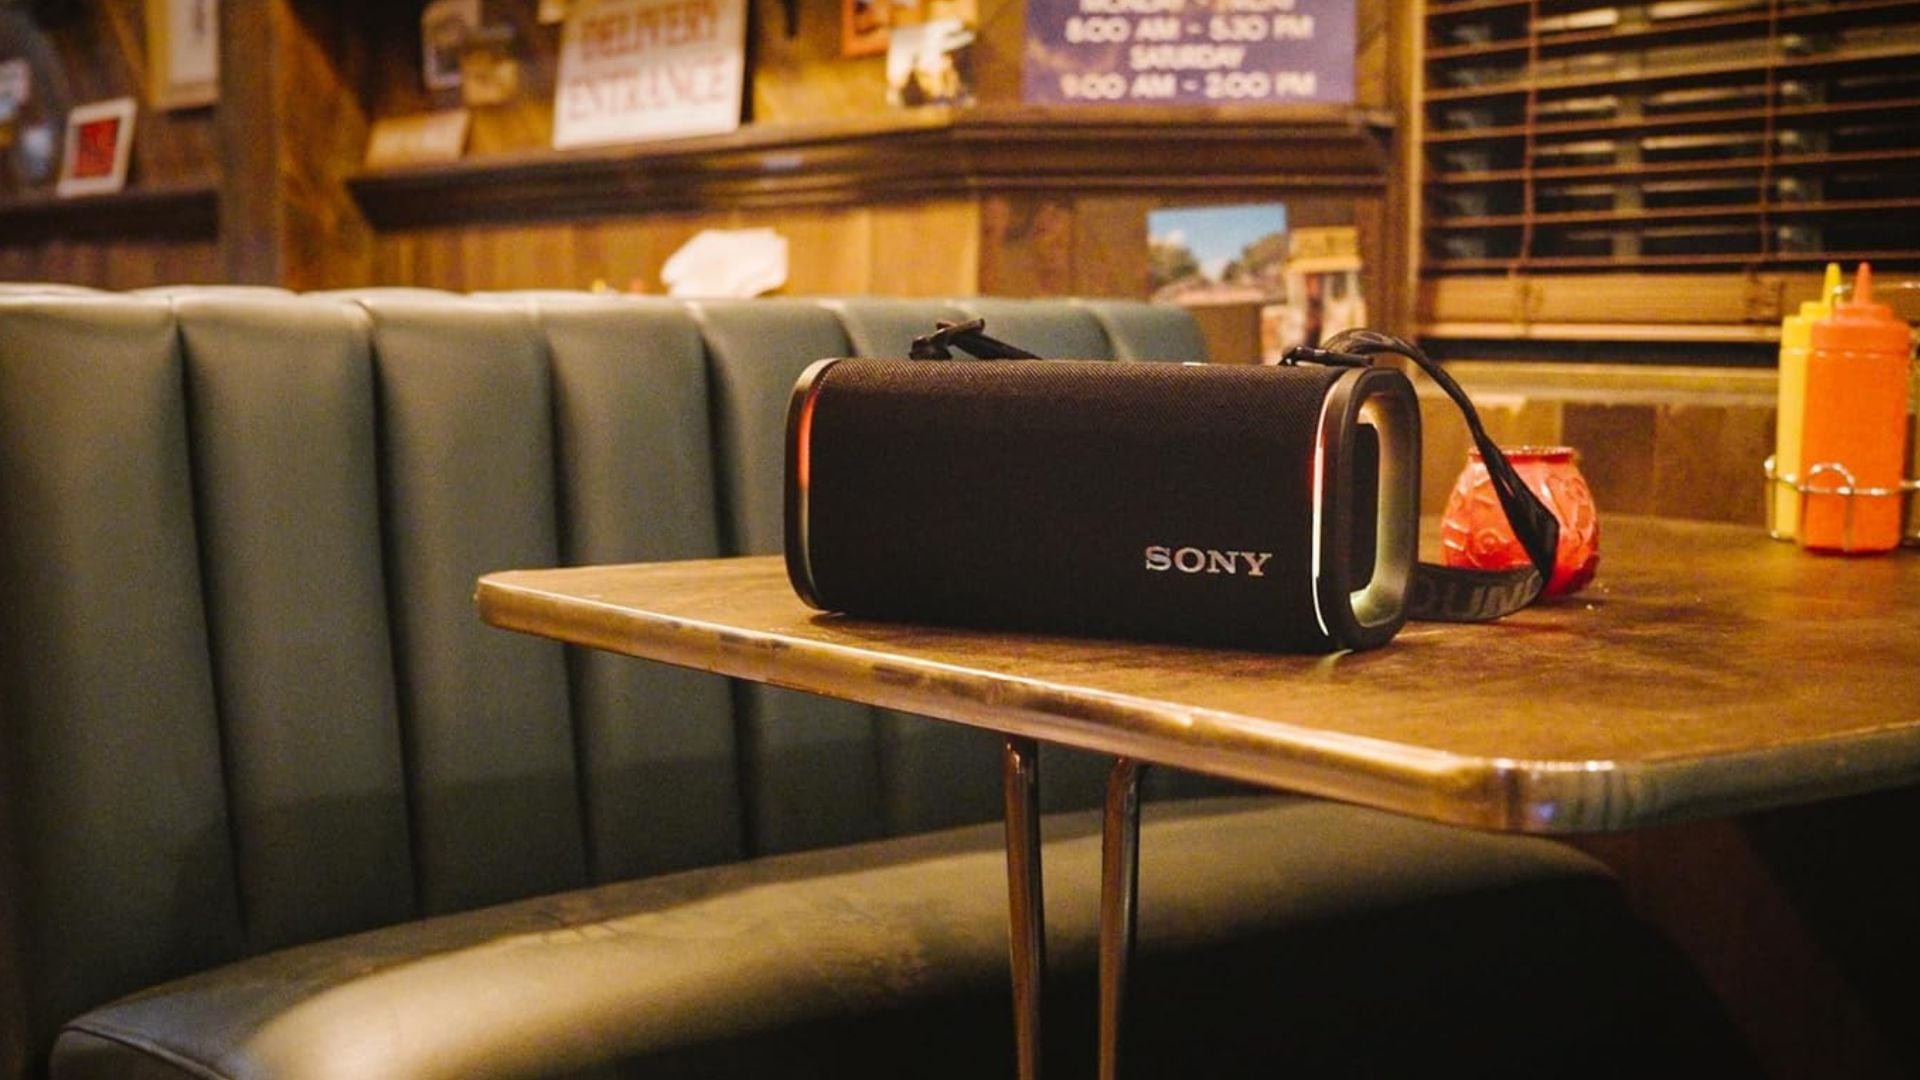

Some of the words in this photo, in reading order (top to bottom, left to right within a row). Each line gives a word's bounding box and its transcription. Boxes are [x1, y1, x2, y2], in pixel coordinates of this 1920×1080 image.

[1134, 17, 1181, 41] AM
[1272, 15, 1315, 40] PM
[1130, 44, 1246, 70] SATURDAY
[1130, 73, 1177, 97] AM
[1275, 72, 1317, 97] PM
[1144, 545, 1273, 577] SONY
